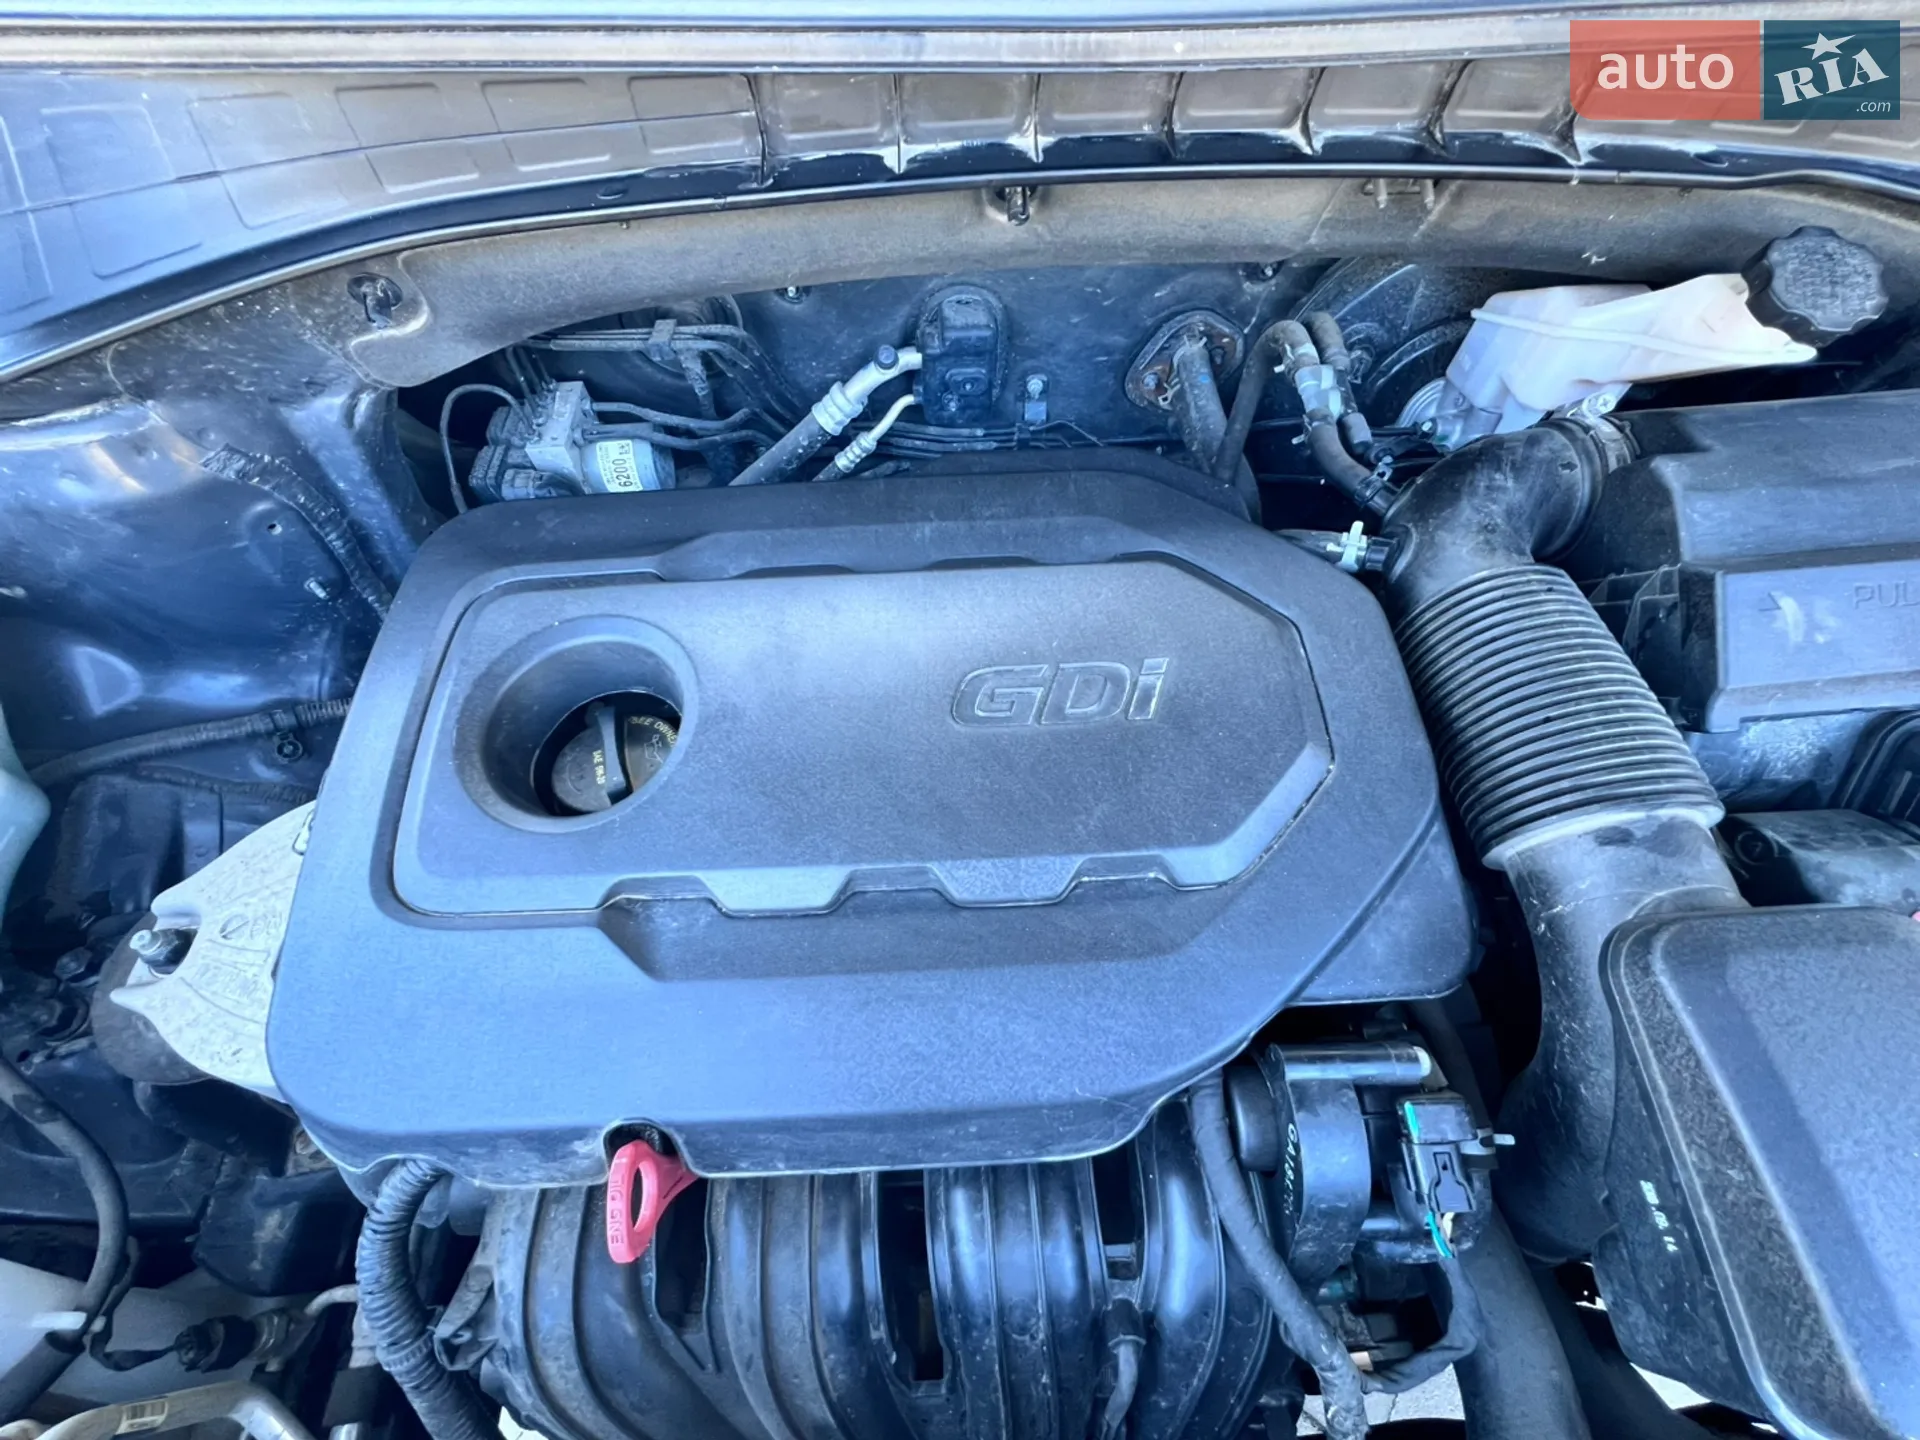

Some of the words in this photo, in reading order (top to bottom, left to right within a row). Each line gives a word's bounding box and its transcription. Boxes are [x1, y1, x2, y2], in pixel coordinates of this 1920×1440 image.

[611, 458, 633, 487] 6200
[951, 657, 1170, 727] GDi
[609, 1208, 625, 1245] ENG
